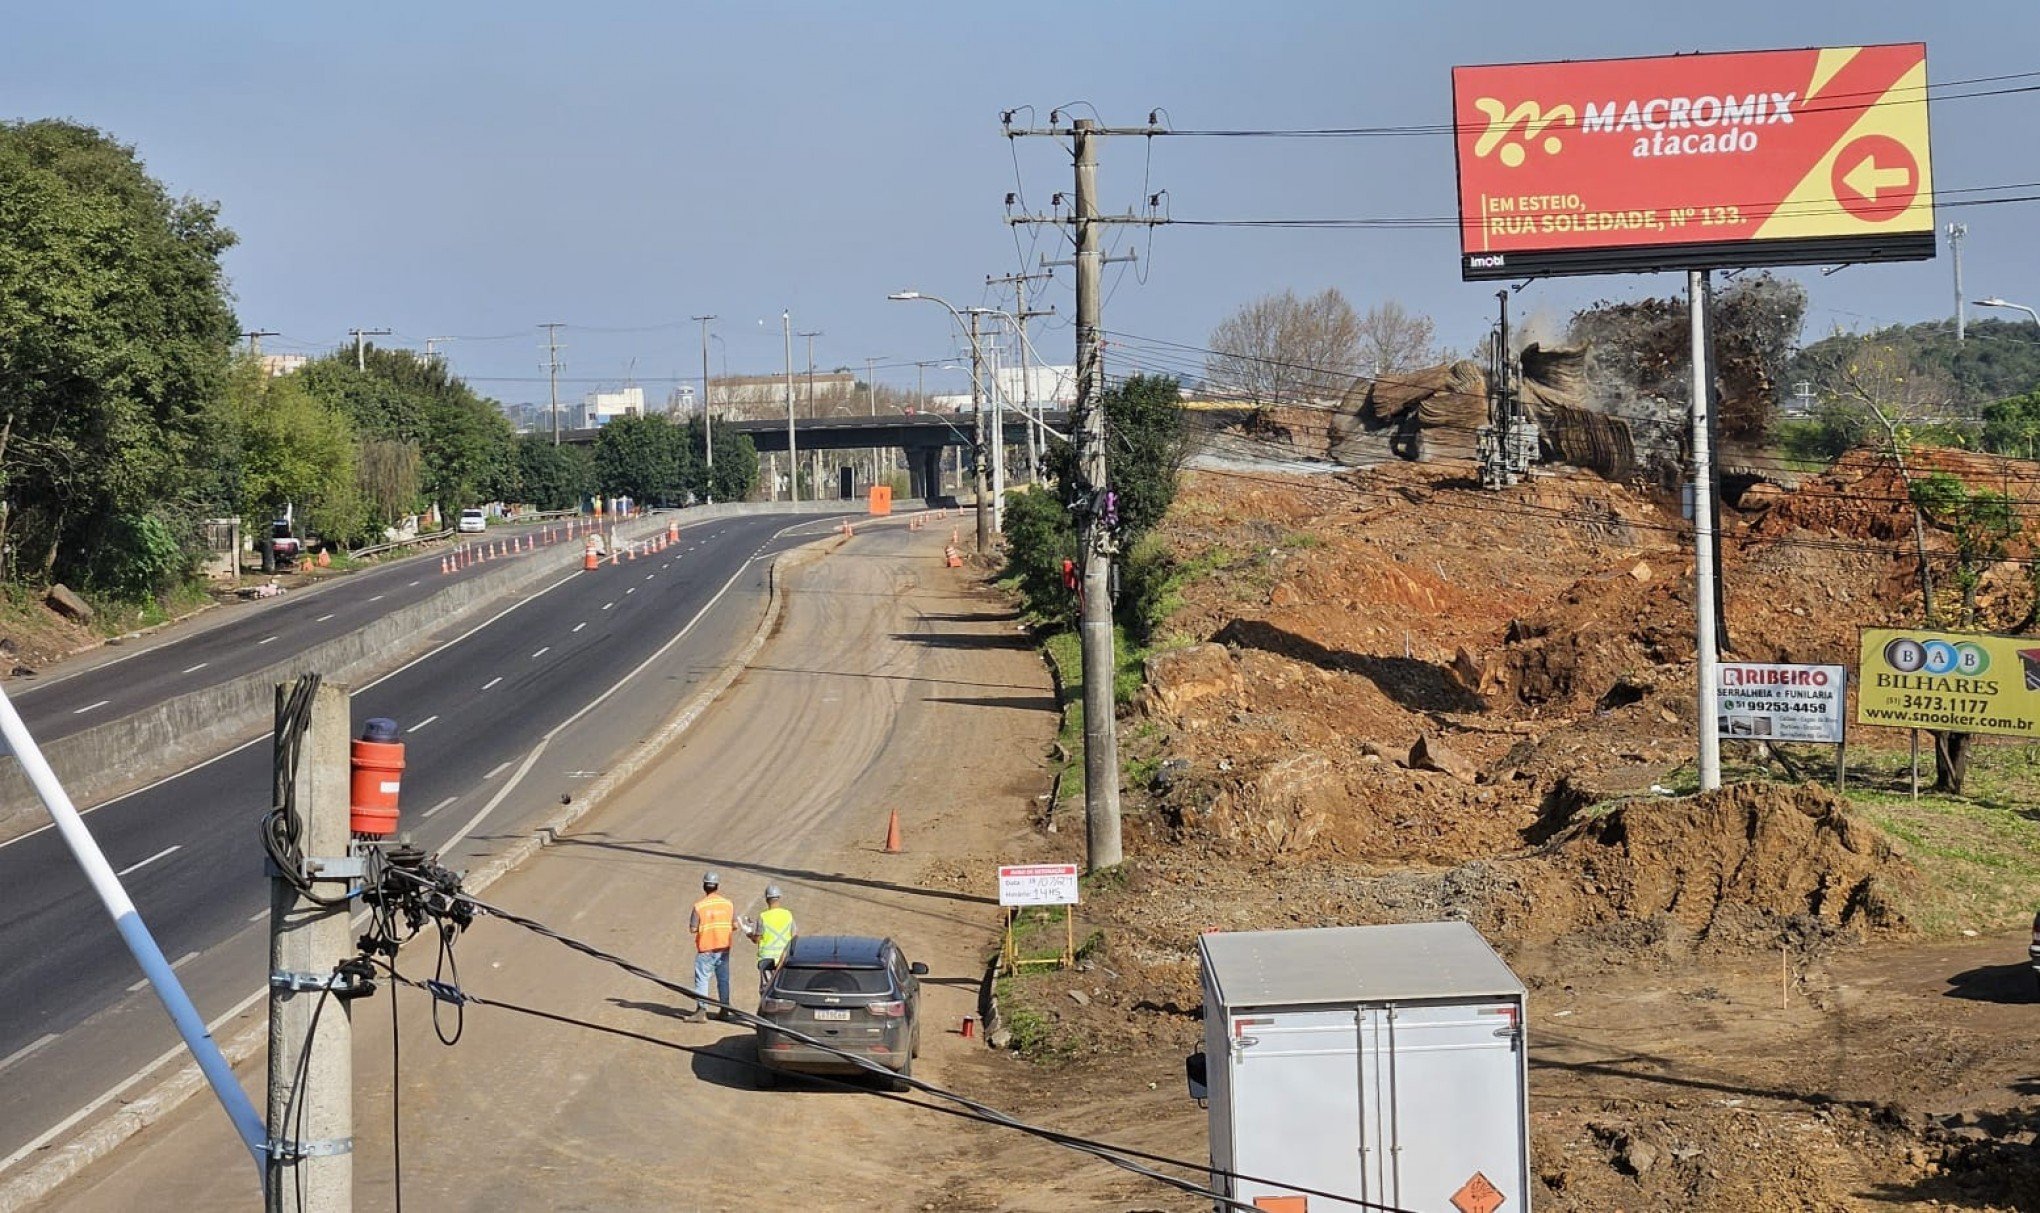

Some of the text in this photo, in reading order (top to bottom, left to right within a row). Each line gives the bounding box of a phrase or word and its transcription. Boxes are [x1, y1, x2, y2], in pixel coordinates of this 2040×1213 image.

[1581, 91, 1798, 133] MACROMIX
[1632, 127, 1758, 158] atacado
[1489, 194, 1586, 212] EM ESTEIO,
[1491, 206, 1748, 235] RUA SOLEDADE, Nº 133.
[1746, 669, 1828, 686] RIBEIRO
[1877, 673, 1999, 696] BILHARES
[1903, 694, 1989, 714] 3473.1177
[1866, 708, 2035, 731] www.snooker.com.br
